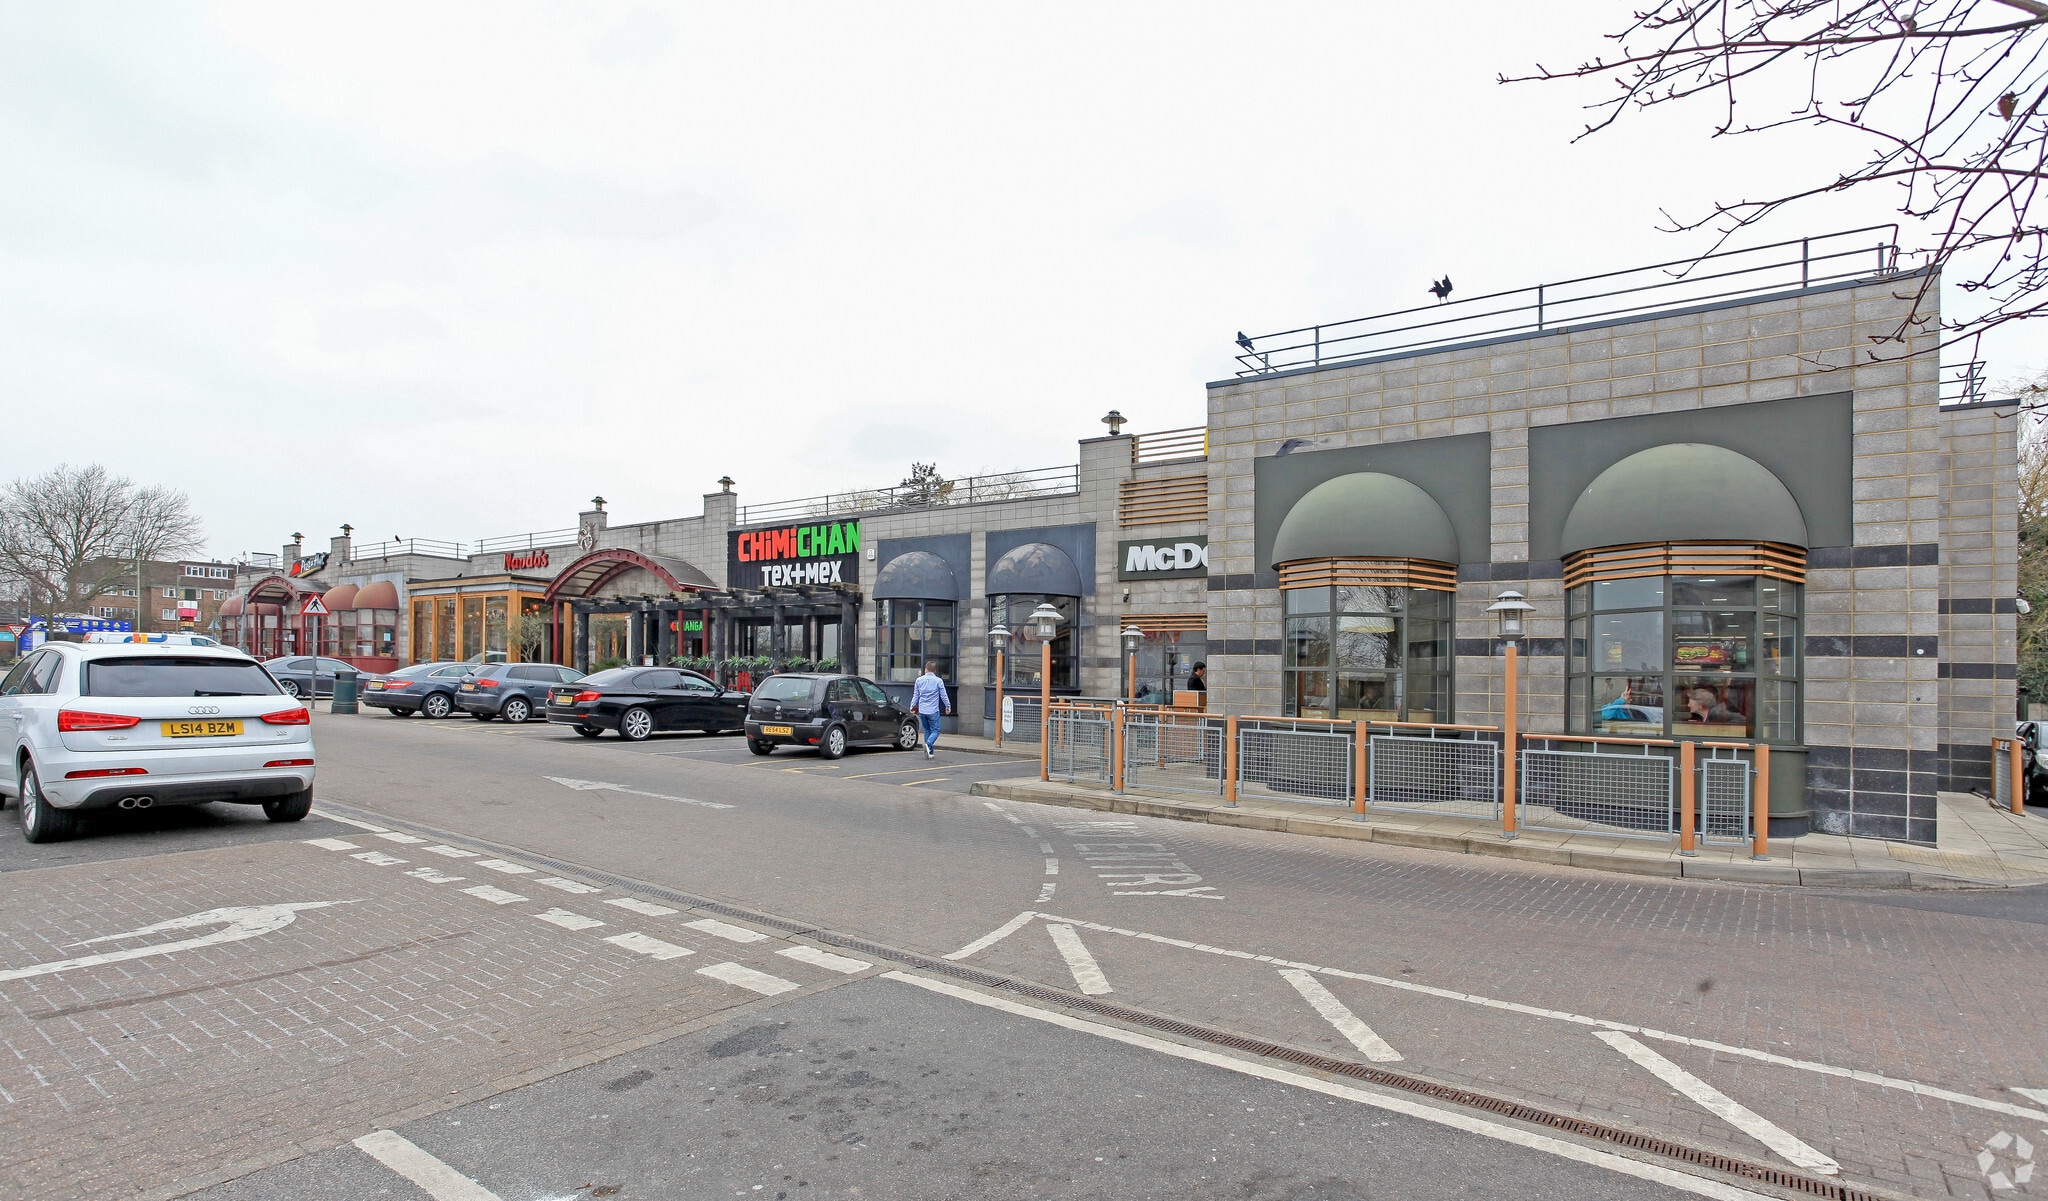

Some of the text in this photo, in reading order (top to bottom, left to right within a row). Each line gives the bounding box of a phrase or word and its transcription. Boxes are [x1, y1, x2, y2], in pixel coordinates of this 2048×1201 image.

[503, 549, 549, 571] Nando's
[1125, 542, 1208, 572] McD
[170, 722, 236, 735] LS14 BZM
[1073, 842, 1226, 900] ENTRY
